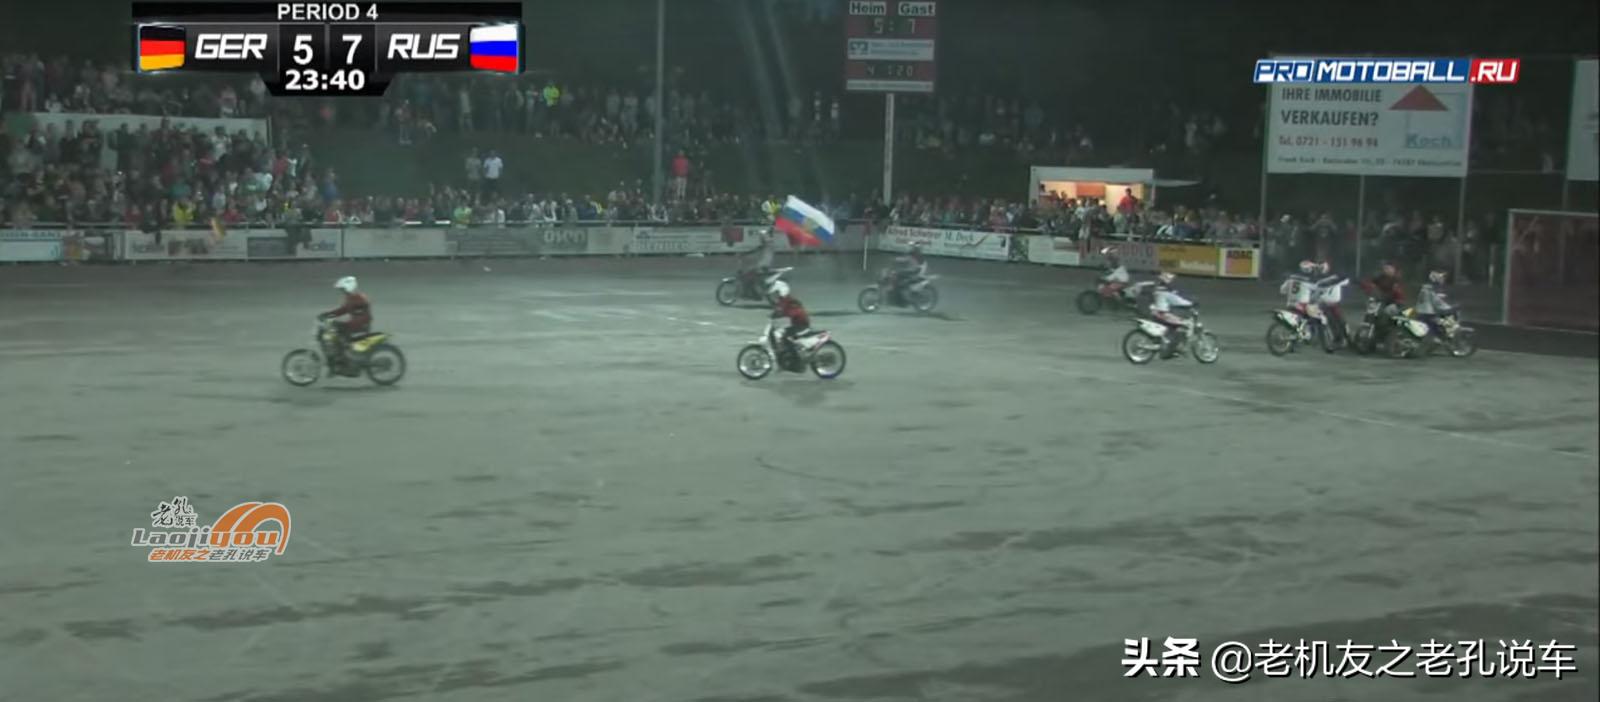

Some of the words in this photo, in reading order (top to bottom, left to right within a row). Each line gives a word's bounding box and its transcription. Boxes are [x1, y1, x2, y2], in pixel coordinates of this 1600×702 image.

[851, 1, 885, 14] Heim
[900, 3, 935, 15] Gast
[1282, 88, 1310, 102] IHRE
[1314, 88, 1382, 103] IMMOBILIE
[1280, 110, 1379, 127] VERKAUFEN?
[1406, 133, 1451, 147] Koch
